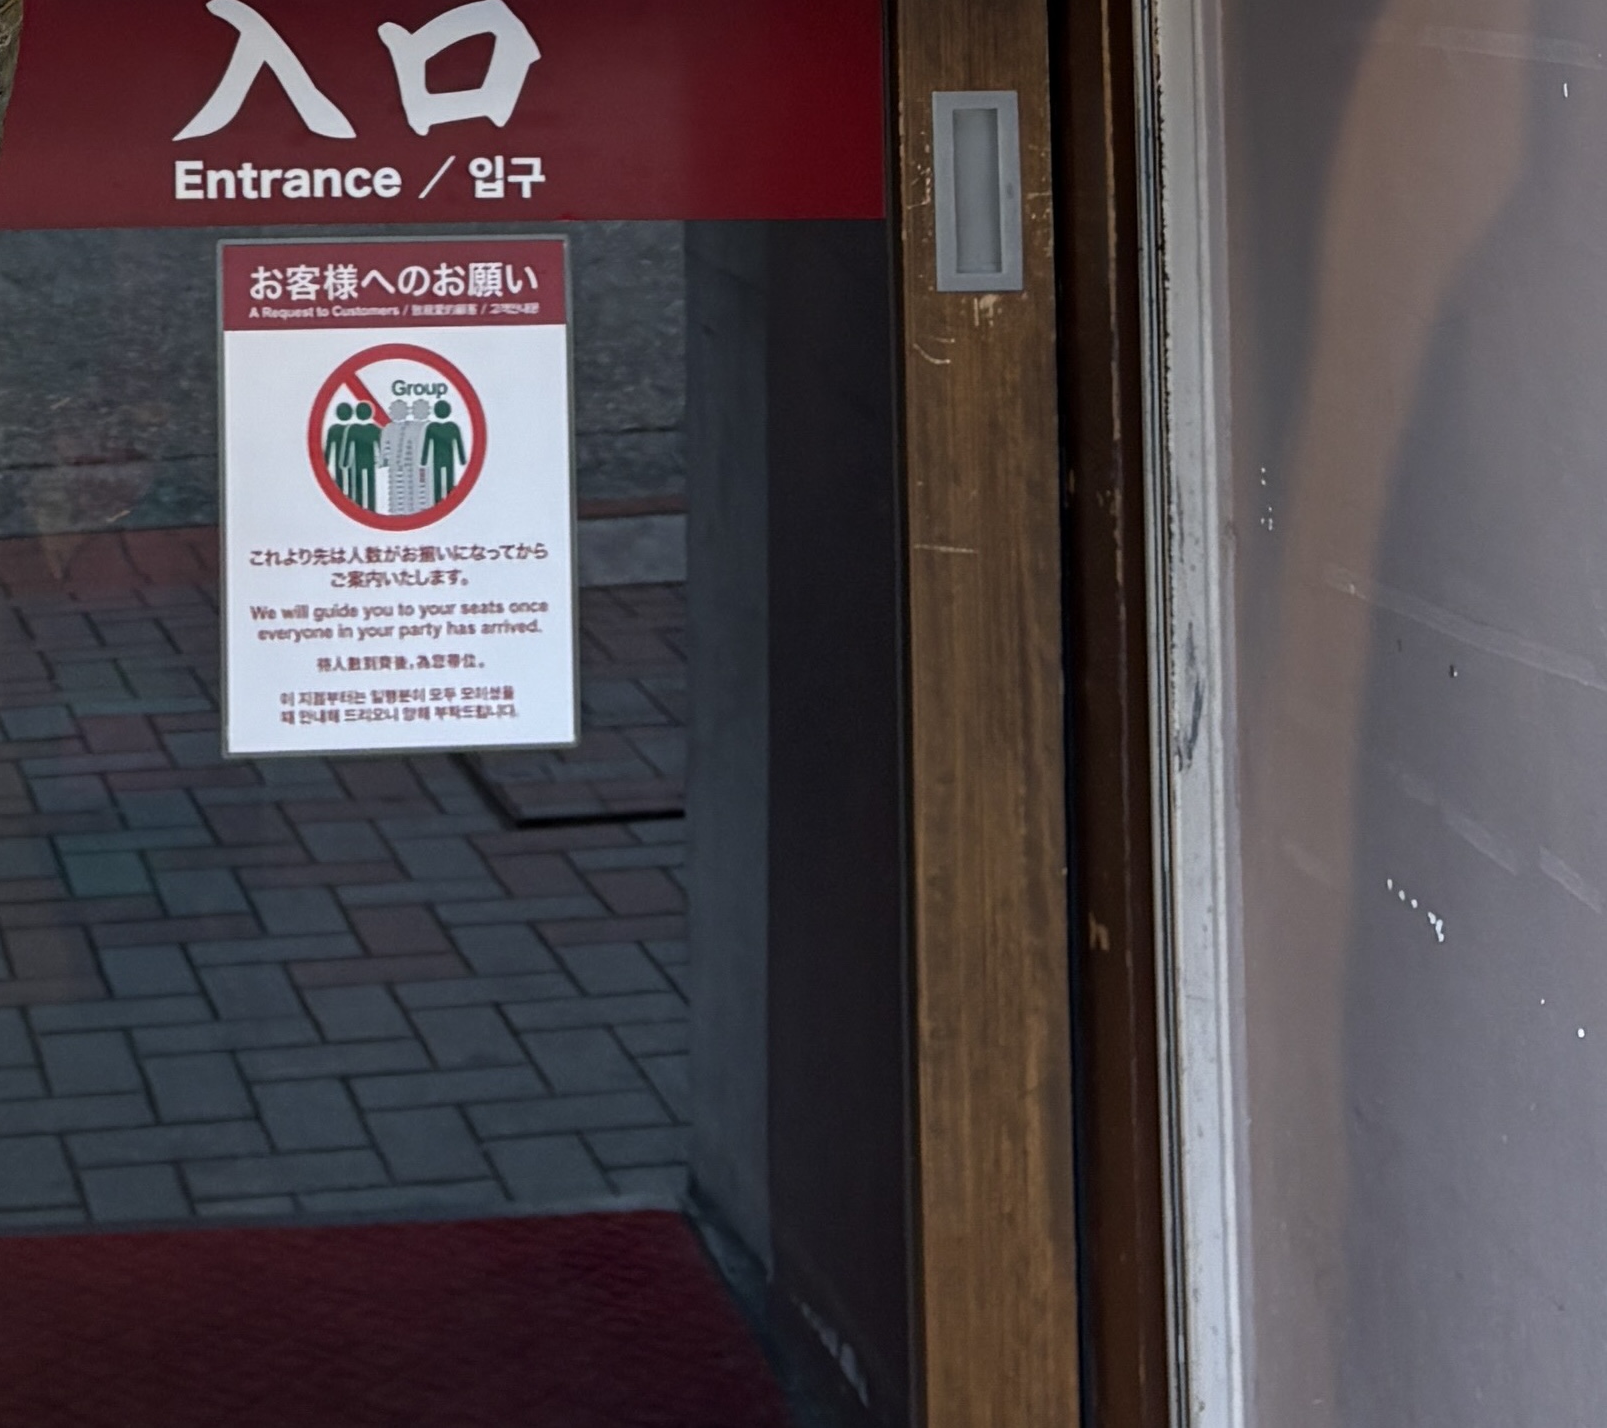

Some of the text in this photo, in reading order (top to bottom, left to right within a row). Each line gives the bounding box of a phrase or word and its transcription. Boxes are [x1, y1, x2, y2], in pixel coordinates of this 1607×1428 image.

[174, 160, 403, 200] Entrance
[469, 155, 546, 199] 입구
[249, 262, 539, 302] お客様へのお願い
[248, 306, 259, 318] A
[262, 305, 315, 320] Request
[316, 306, 330, 318] to
[332, 304, 400, 317] Customers
[391, 379, 448, 399] Group
[330, 568, 469, 588] ご案内いたします。
[250, 601, 549, 622] We will guide you to your seats once
[258, 619, 543, 643] everyone in your party has arrived.
